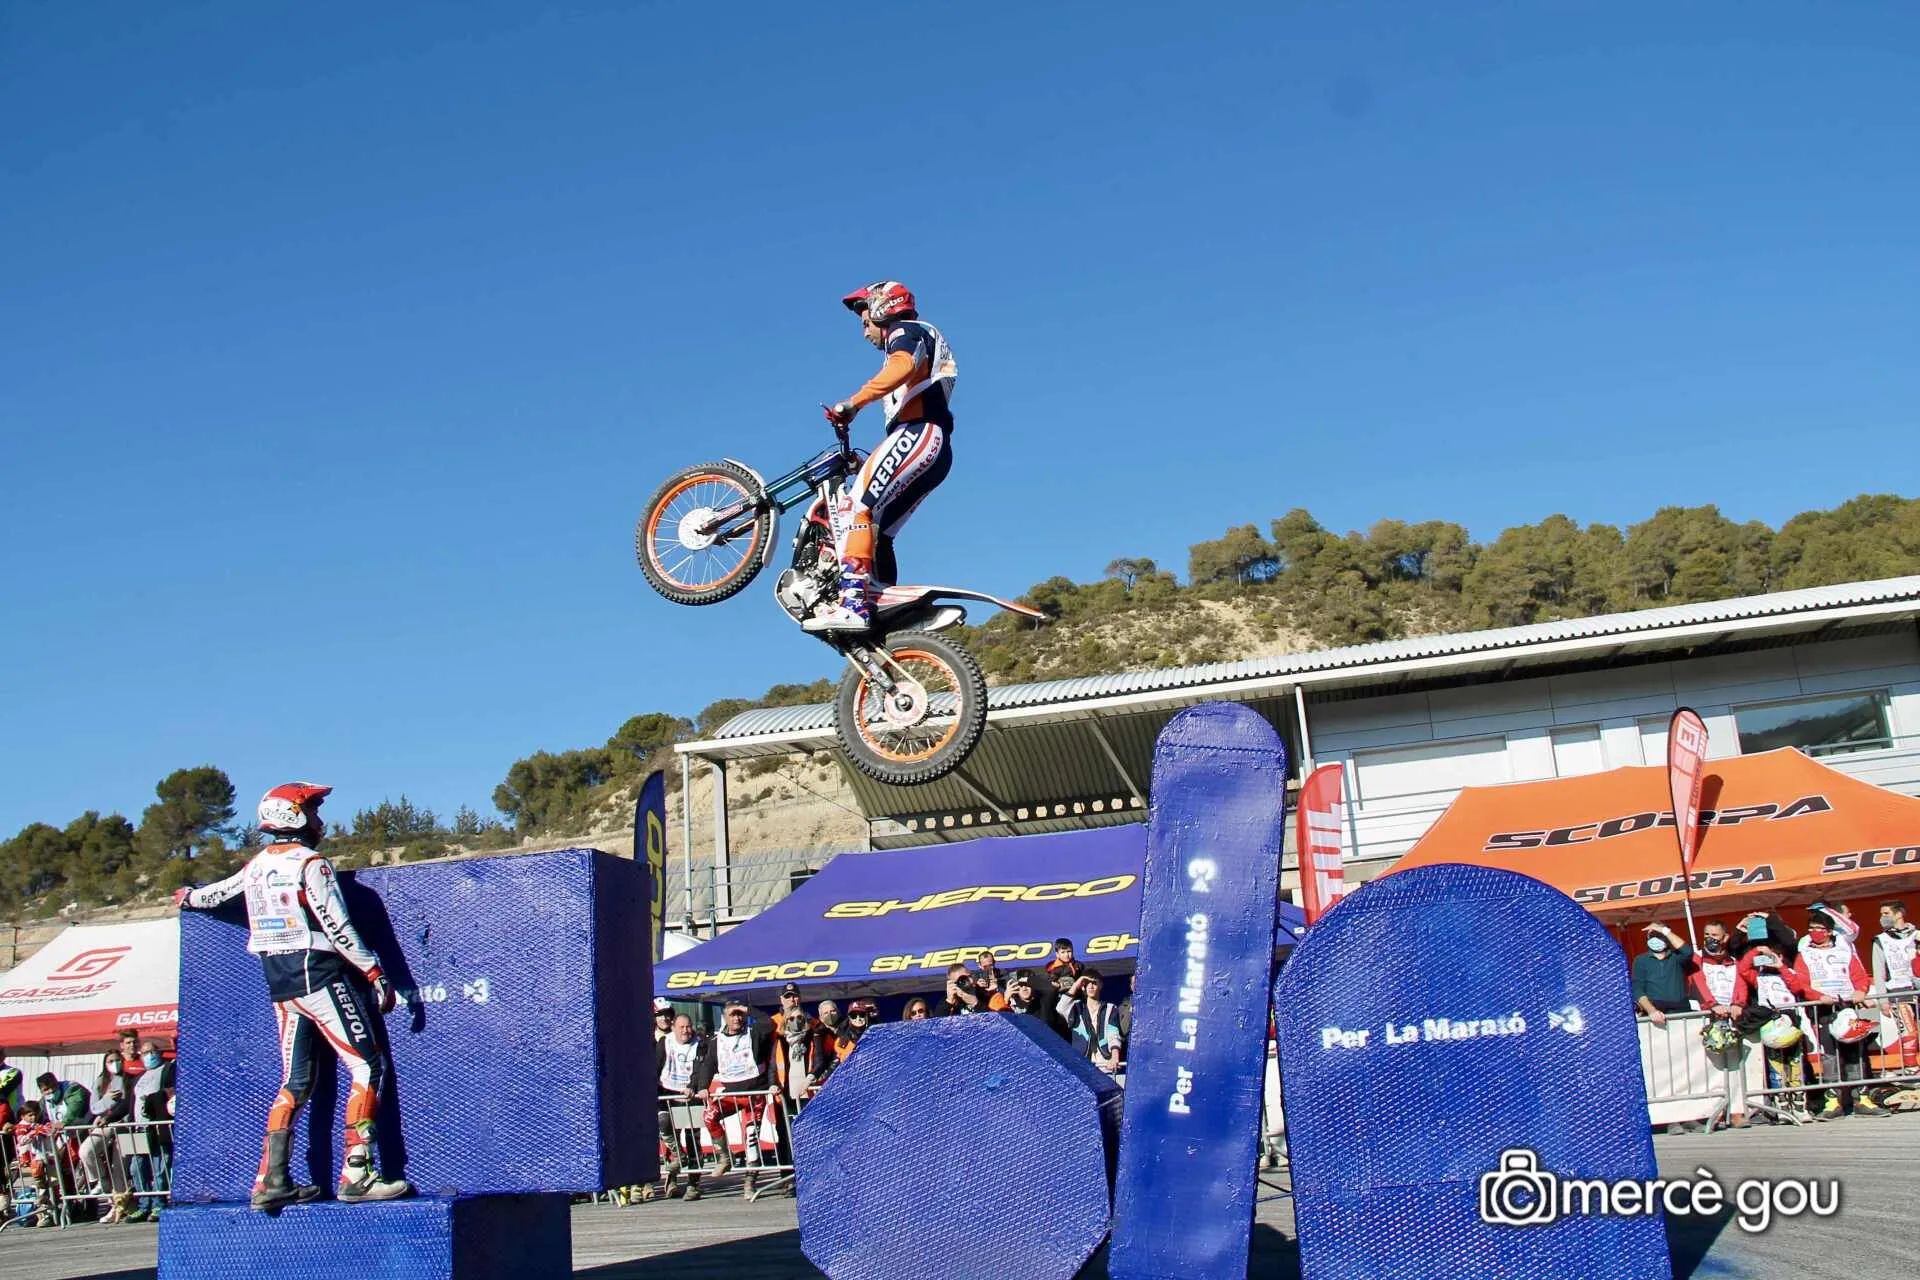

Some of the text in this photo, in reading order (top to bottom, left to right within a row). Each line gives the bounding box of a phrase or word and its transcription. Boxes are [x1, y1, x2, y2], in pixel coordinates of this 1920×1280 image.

[868, 429, 919, 499] REPSOL
[1483, 794, 1833, 851] SCORPA
[823, 874, 1138, 919] SHERCO
[1571, 864, 1776, 904] SCORPA
[666, 960, 839, 989] SHERCO
[868, 941, 1054, 973] SHERCO
[0, 980, 117, 999] GASGAS
[332, 982, 368, 1043] REPSOL
[1321, 1025, 1370, 1050] Per
[1385, 1021, 1419, 1046] La
[1424, 1012, 1526, 1041] Marató
[1174, 1017, 1198, 1050] La
[1168, 1065, 1194, 1114] Per
